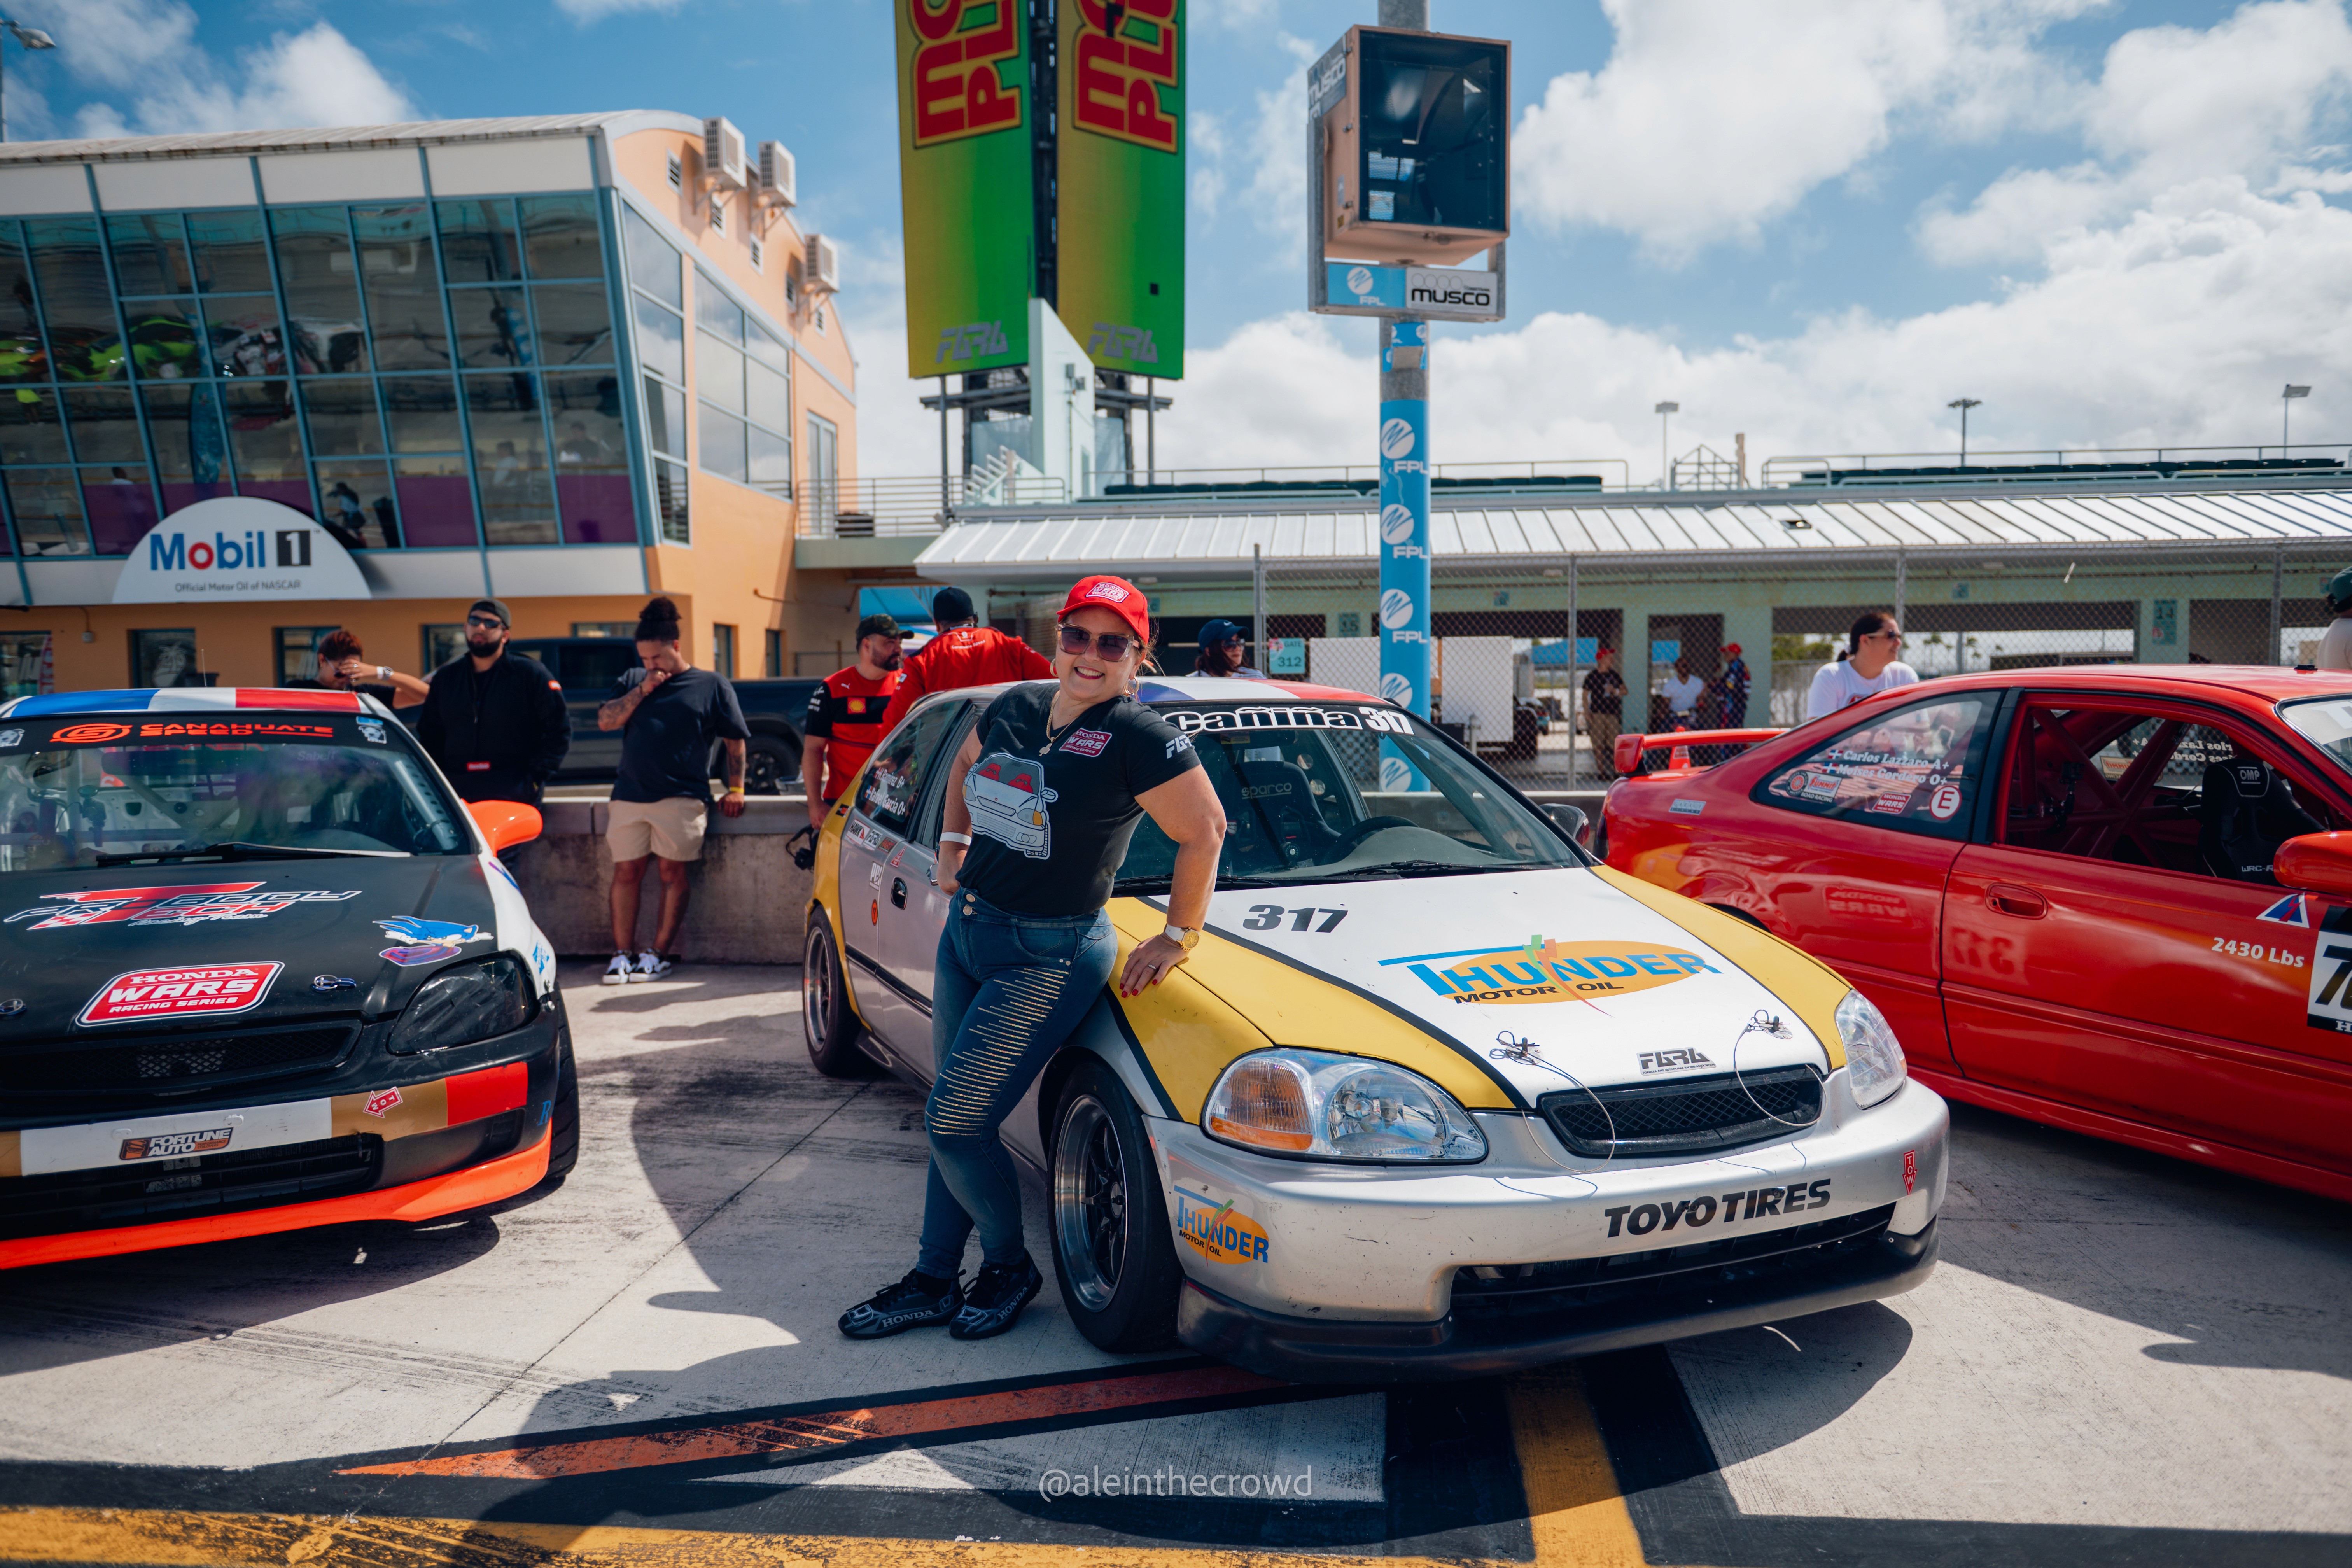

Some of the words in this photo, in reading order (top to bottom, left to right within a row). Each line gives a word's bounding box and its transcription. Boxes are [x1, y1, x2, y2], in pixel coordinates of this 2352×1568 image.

[1360, 296, 1384, 305] FPL
[1394, 460, 1428, 474] FPL
[150, 530, 266, 570] Mobil
[1393, 546, 1428, 559] FPL
[175, 583, 206, 593] Official
[209, 583, 234, 592] Motor
[236, 581, 248, 592] Oil
[250, 580, 259, 591] of
[262, 579, 301, 590] NASCAR
[1099, 584, 1124, 595] HONDA
[1392, 630, 1428, 644] FPL
[1278, 656, 1302, 667] 312
[140, 724, 333, 733] CANAHUATE
[1358, 707, 1414, 735] 317
[1068, 737, 1104, 749] WARS
[1076, 730, 1105, 740] HONDA
[1843, 751, 1880, 763] Carlos
[1881, 754, 1929, 767] Lazzaro
[1931, 759, 1950, 770] A+
[1836, 764, 1875, 778] Moises
[1877, 768, 1926, 784] Cordero
[1930, 774, 1948, 785] O+
[2240, 769, 2260, 780] OMP
[1242, 782, 1292, 798] sparco
[882, 794, 899, 814] Garcia
[1878, 800, 1904, 808] WARS
[1937, 791, 1955, 809] E
[156, 891, 362, 908] BODY
[128, 916, 210, 926] Racing
[1243, 905, 1349, 933] 317
[2211, 937, 2263, 959] 2430
[2268, 947, 2305, 968] Lbs
[130, 969, 259, 984] HONDA
[1378, 944, 1724, 996] THUNDER
[108, 979, 259, 1003] WARS
[1454, 986, 1560, 1004] MOTOR
[1576, 982, 1624, 991] OIL
[109, 1002, 172, 1013] RACING
[176, 997, 238, 1007] SERIES
[371, 1095, 395, 1110] TOW
[150, 1129, 231, 1147] FORTUNE
[147, 1142, 196, 1156] AUTO
[1605, 1195, 1717, 1238] TOYO
[1722, 1178, 1831, 1223] TIRES
[1174, 1185, 1269, 1263] THUNDER
[1179, 1229, 1205, 1248] MOTOR
[1209, 1245, 1222, 1257] OIL
[997, 1286, 1028, 1320] HONDA
[882, 1309, 934, 1328] HONDA
